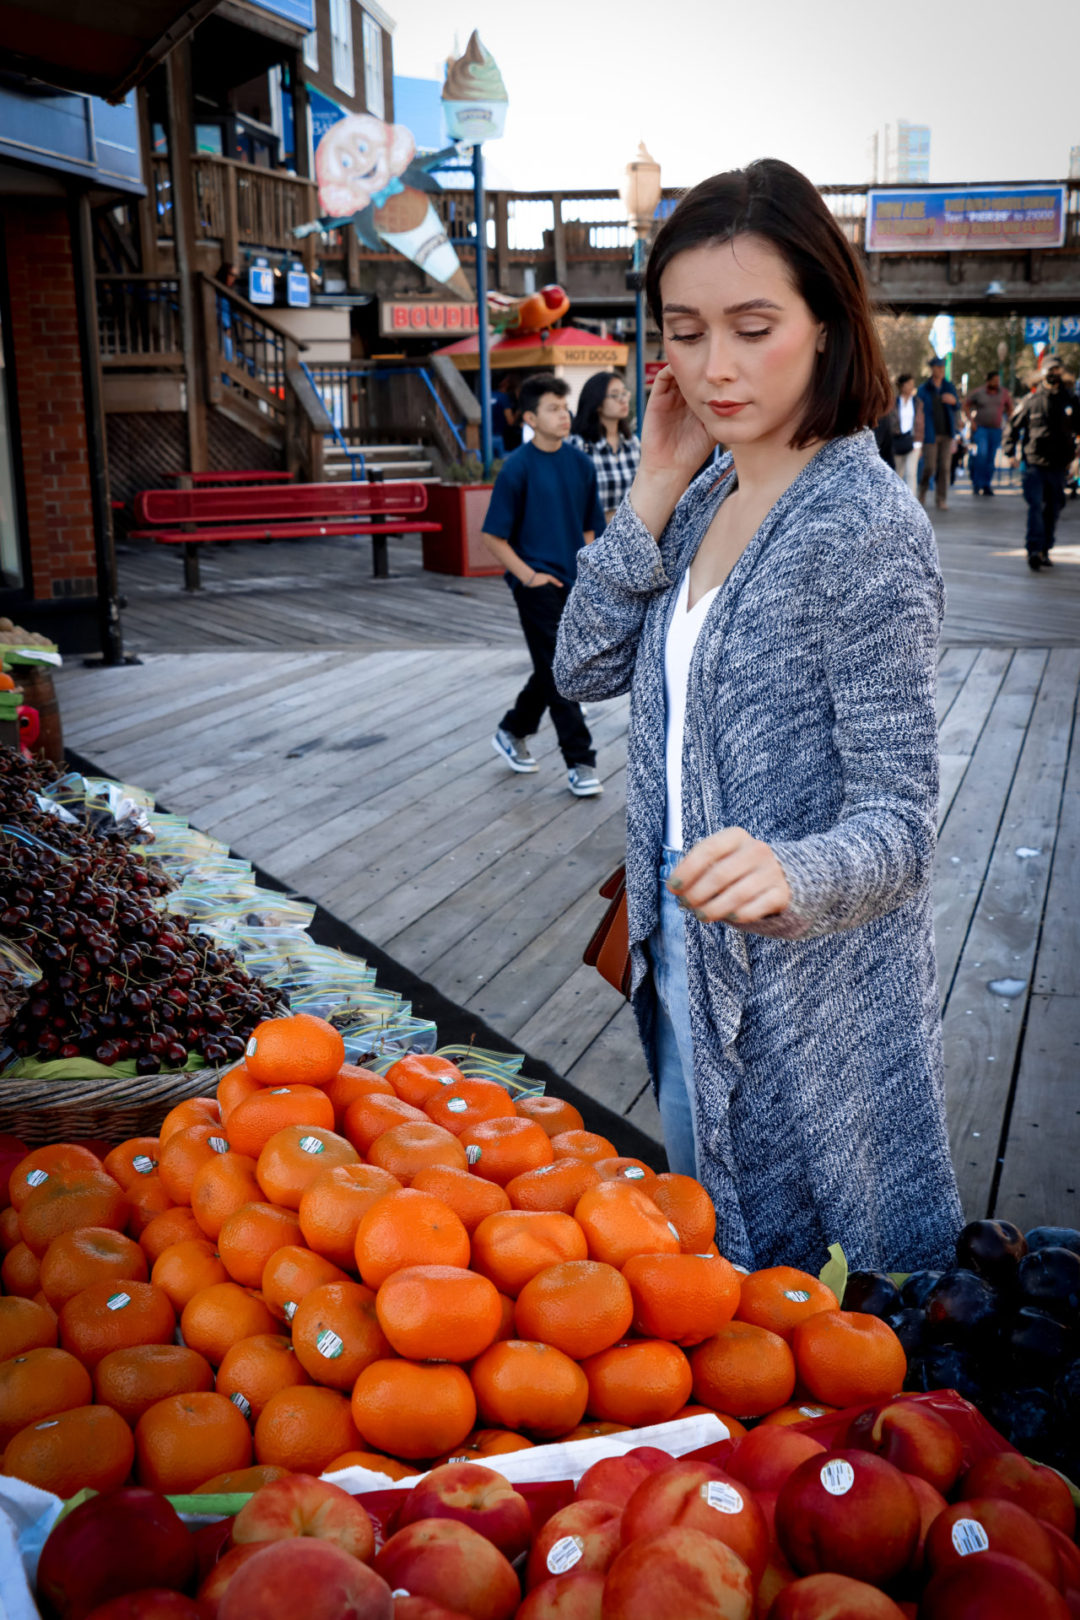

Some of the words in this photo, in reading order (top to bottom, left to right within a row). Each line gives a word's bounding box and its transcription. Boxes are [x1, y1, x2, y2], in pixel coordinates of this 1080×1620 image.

[1028, 318, 1049, 337] 39
[565, 350, 586, 361] HOT
[589, 350, 618, 361] DOGS
